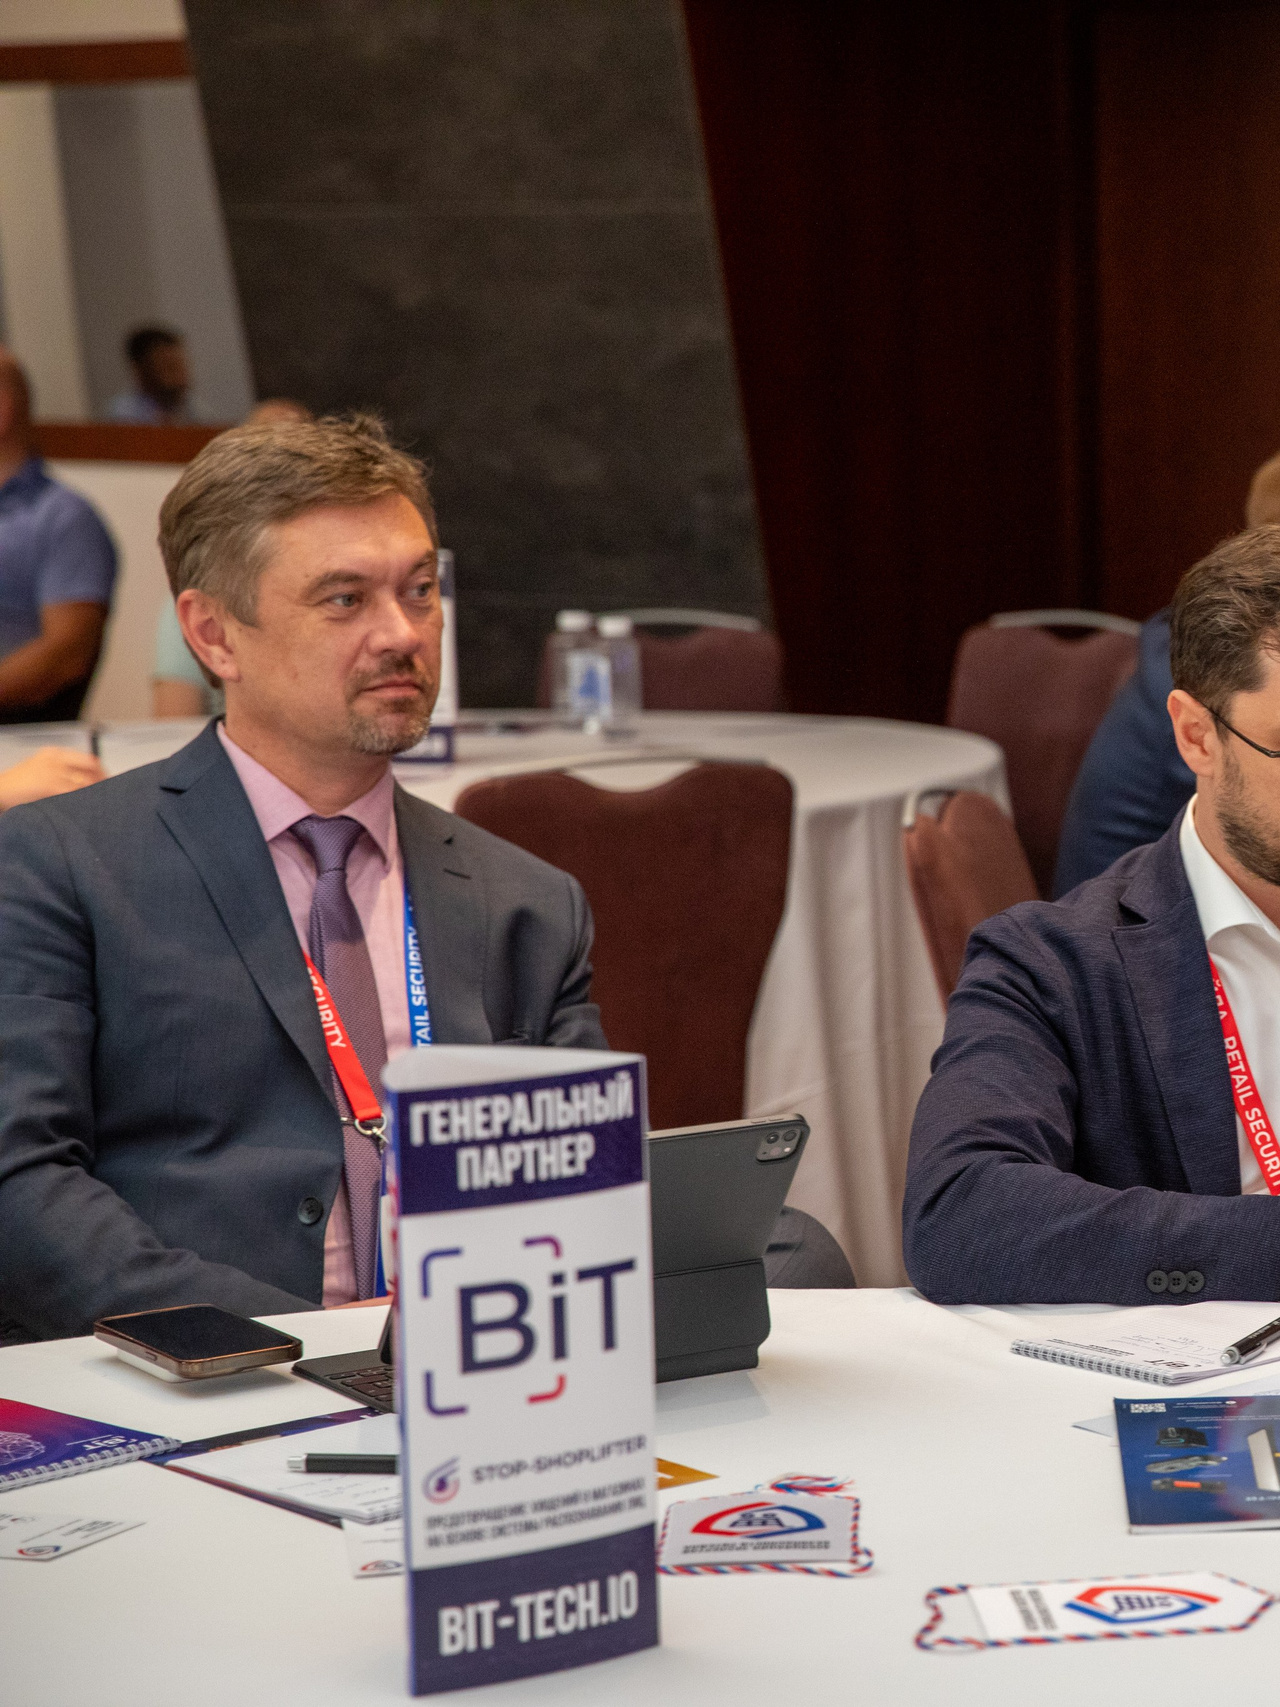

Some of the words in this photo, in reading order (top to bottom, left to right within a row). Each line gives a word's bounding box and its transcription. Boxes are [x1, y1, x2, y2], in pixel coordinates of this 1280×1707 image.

[1223, 1036, 1254, 1106] RETAIL
[409, 1070, 634, 1147] ГЕНЕРАЛЬНЫЙ
[456, 1132, 595, 1192] ПАРТНЕР
[473, 1433, 647, 1484] STOP-SHOPLIFTER
[438, 1571, 639, 1656] BIT-TECH.IO
